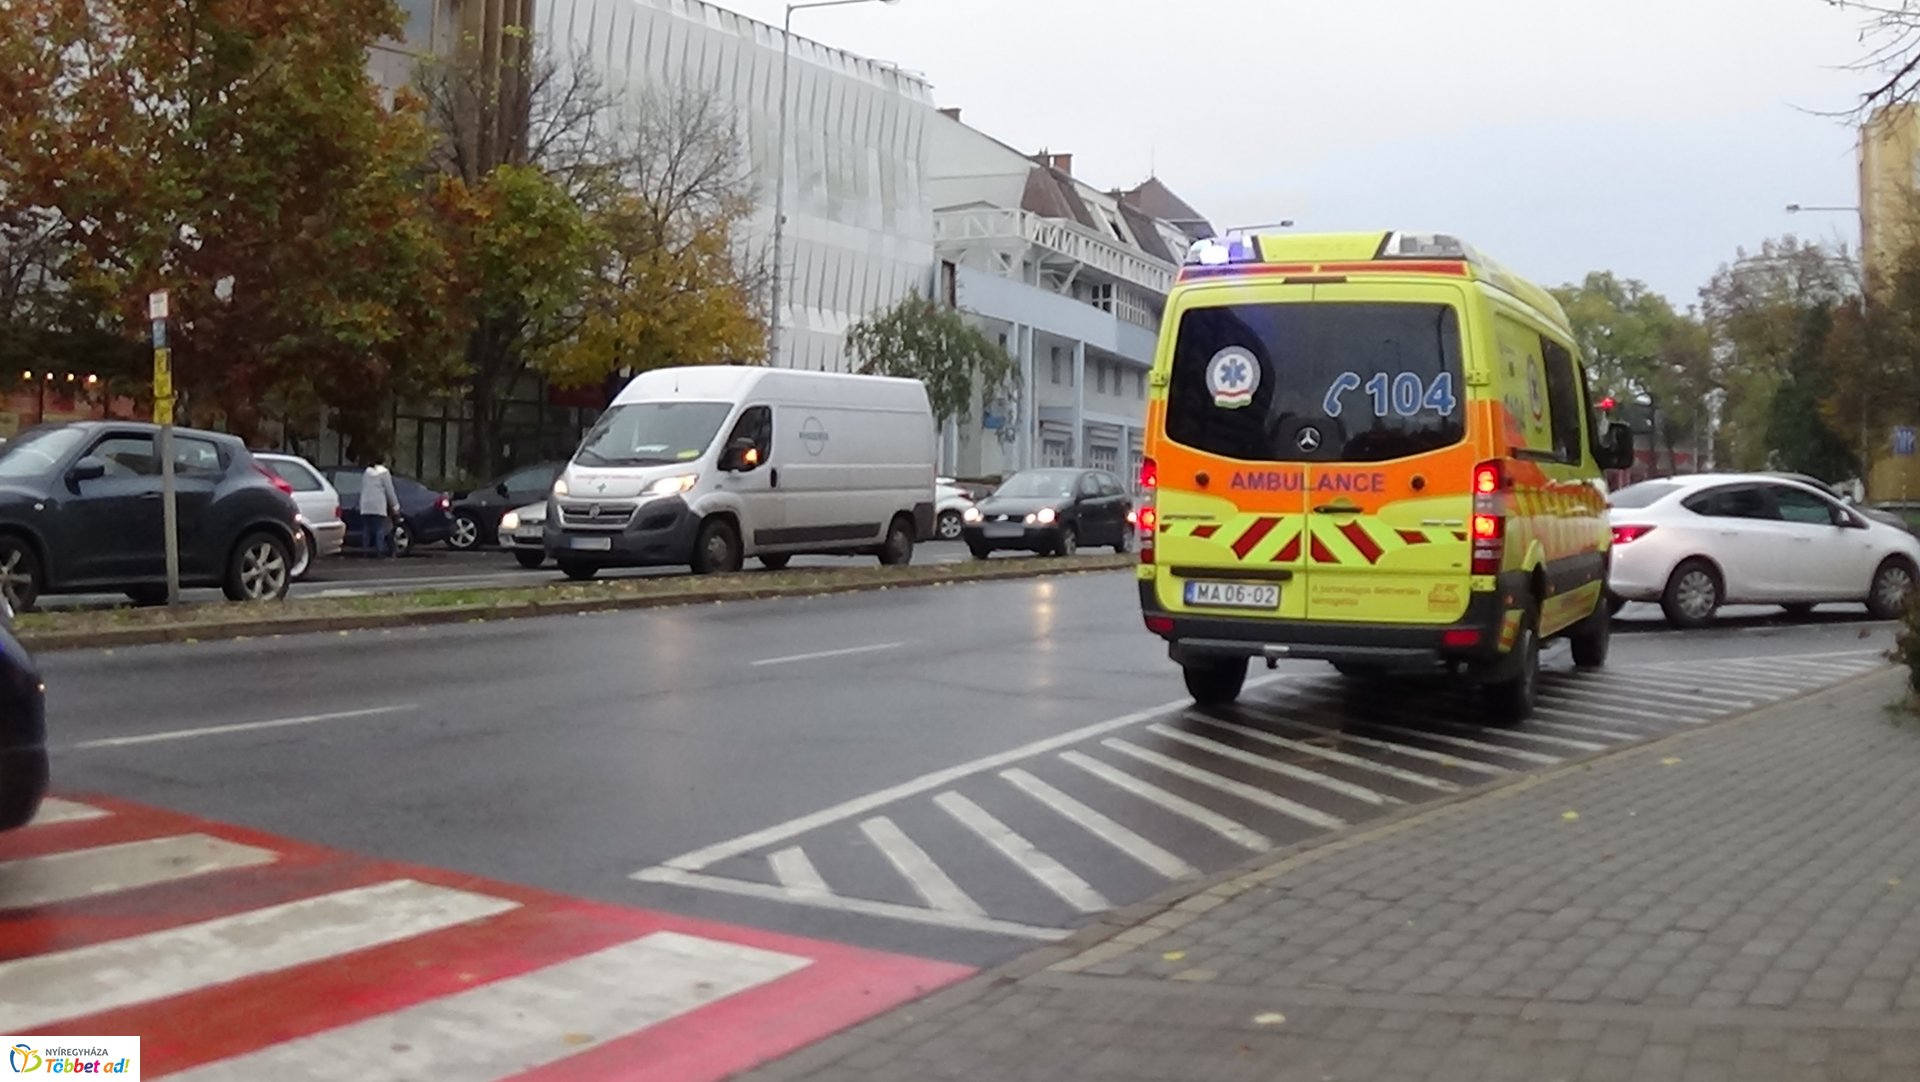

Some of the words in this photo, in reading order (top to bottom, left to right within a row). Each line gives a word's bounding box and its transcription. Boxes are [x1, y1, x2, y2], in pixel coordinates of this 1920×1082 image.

[1365, 371, 1456, 416] 104
[1230, 472, 1385, 493] AMBULANCE
[1197, 584, 1221, 601] MA
[1224, 585, 1275, 604] 06-02
